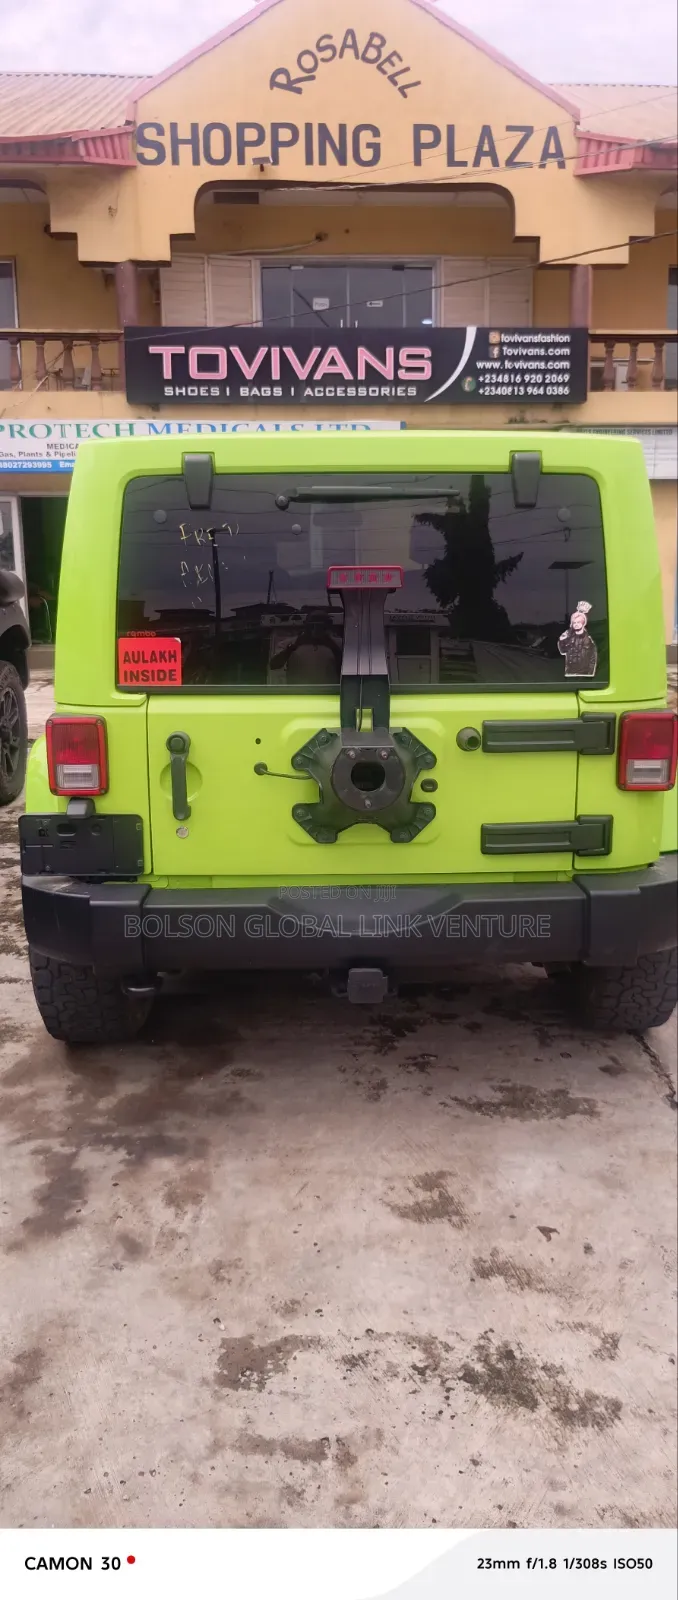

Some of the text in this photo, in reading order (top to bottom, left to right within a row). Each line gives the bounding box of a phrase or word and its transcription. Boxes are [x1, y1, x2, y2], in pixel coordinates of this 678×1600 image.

[270, 28, 421, 98] ROSABELL
[136, 121, 566, 169] SHOPPING PLAZA
[501, 332, 571, 343] tovivansfashion
[502, 346, 571, 356] Tovivans.com
[149, 346, 432, 380] TOVIVANS
[524, 374, 543, 384] 920
[545, 373, 570, 383] 2069
[164, 386, 220, 397] SHOES
[240, 386, 283, 397] BAGS
[303, 386, 417, 397] ACCESSORIES
[527, 386, 544, 395] 964
[546, 386, 570, 395] 0386
[123, 650, 178, 664] AULAKH
[123, 669, 178, 682] INSIDE
